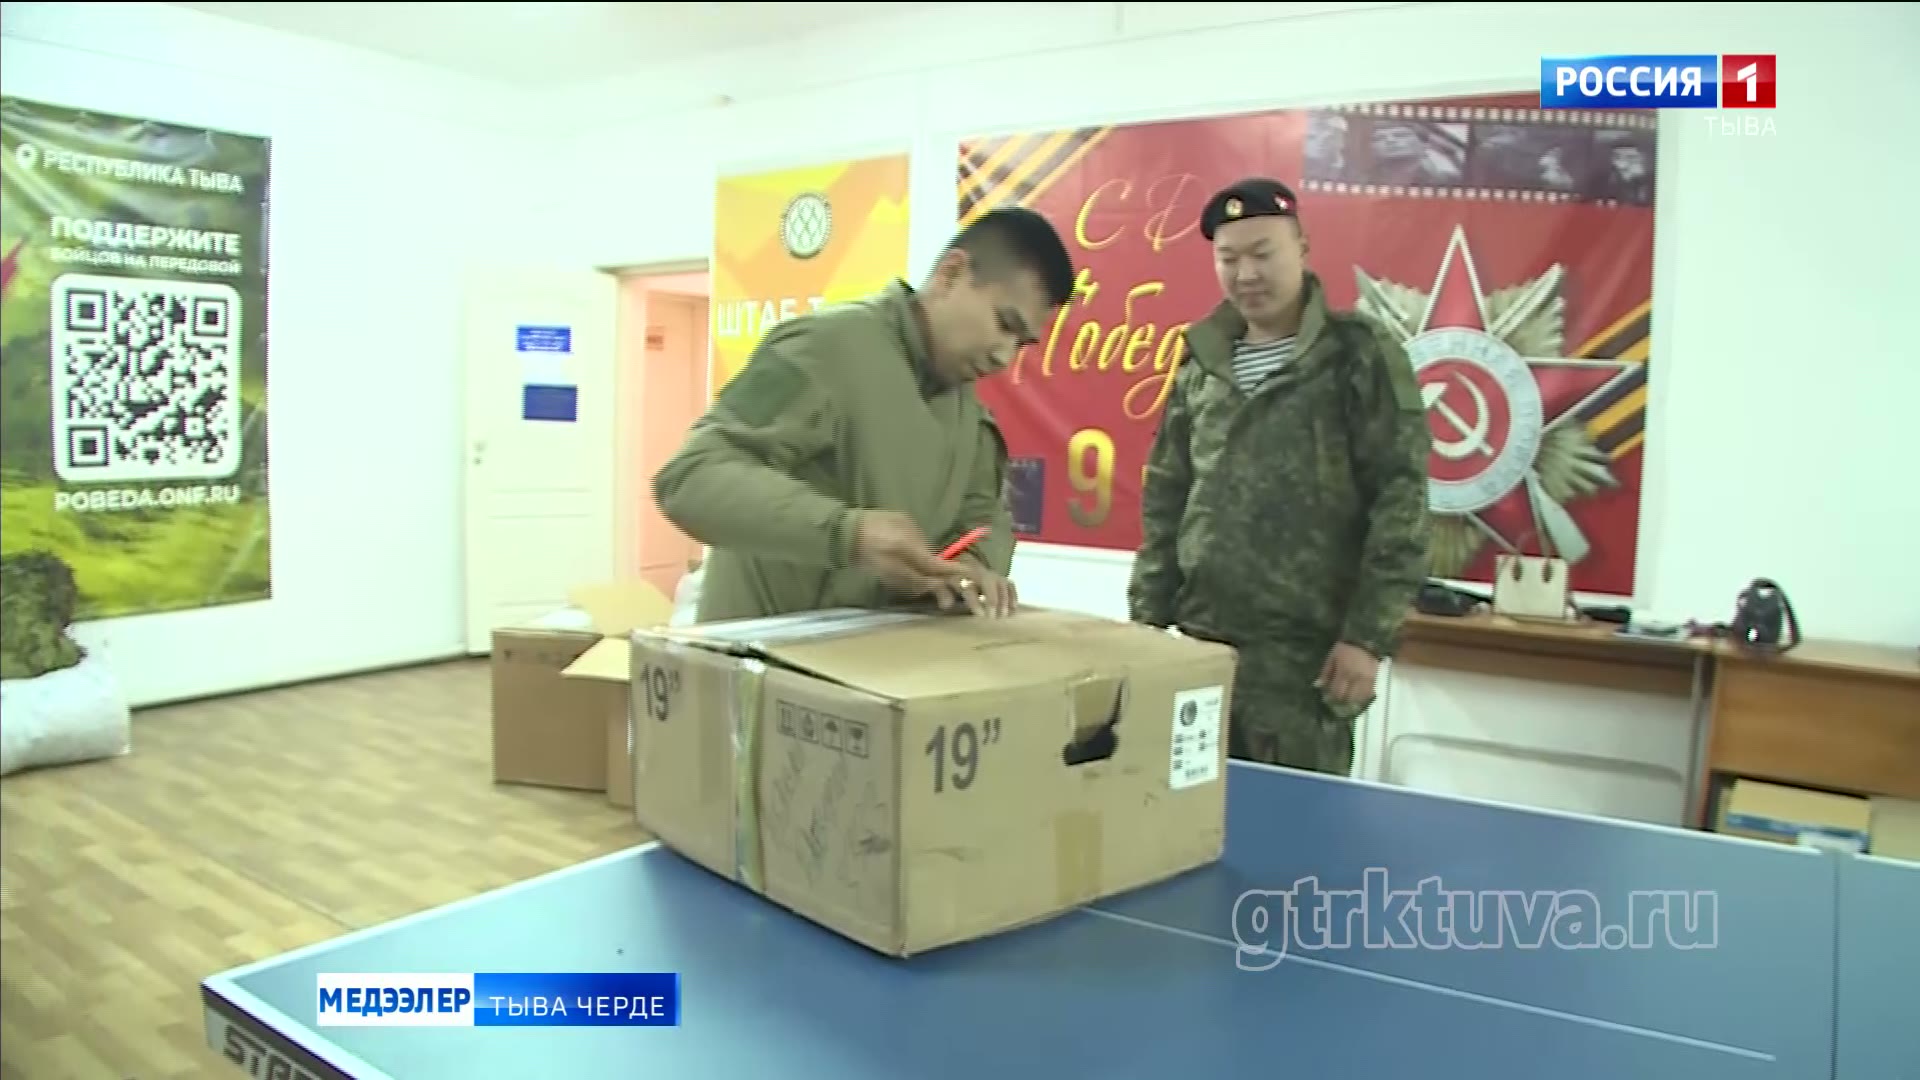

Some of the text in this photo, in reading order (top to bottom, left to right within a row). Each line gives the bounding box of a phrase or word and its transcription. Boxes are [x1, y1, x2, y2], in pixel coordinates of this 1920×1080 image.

[42, 149, 244, 193] РЕСПУБЛИКА ТЫВА
[1075, 173, 1203, 251] С Д
[50, 216, 242, 255] ПОДДЕРЖИТЕ
[124, 253, 148, 267] НА
[149, 255, 242, 274] ПЕРЕДОВОЙ
[1010, 268, 1192, 420] Побед
[55, 484, 240, 511] POBEDA.ONF.RU
[1066, 427, 1117, 528] 9
